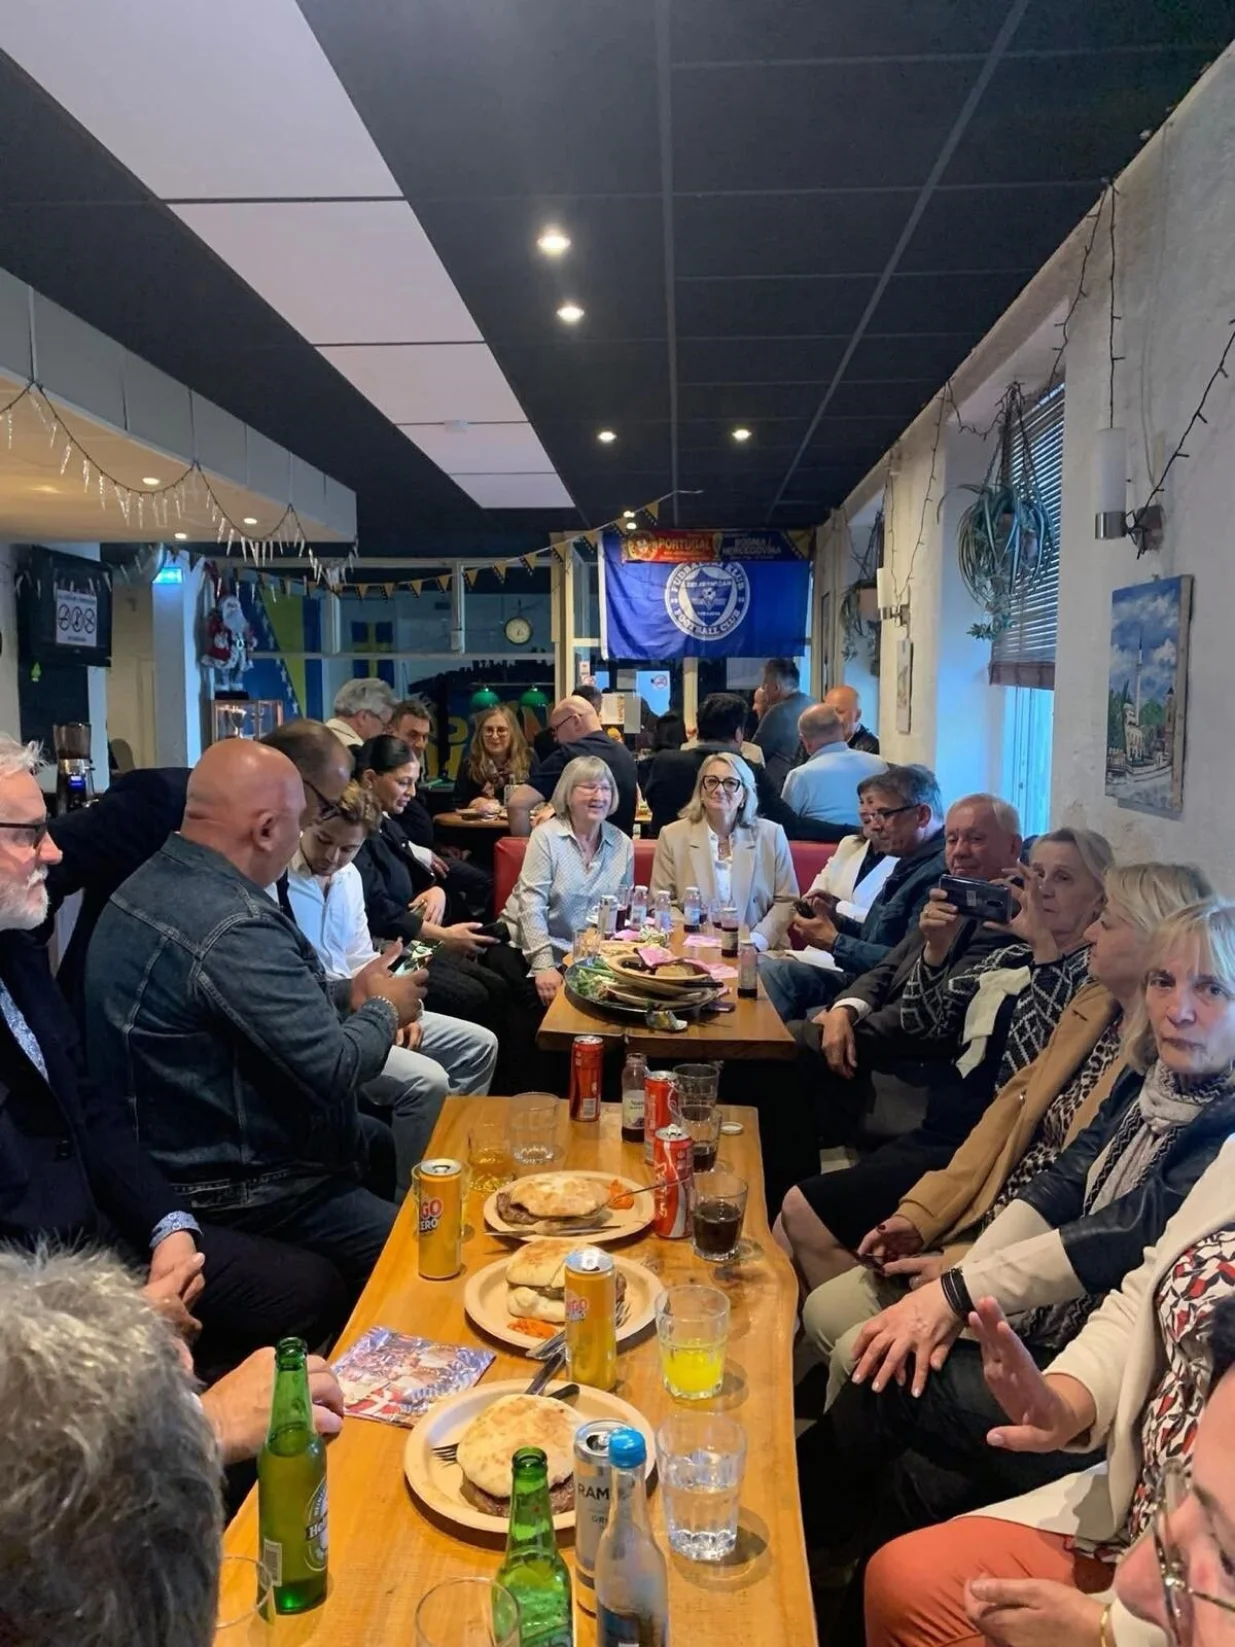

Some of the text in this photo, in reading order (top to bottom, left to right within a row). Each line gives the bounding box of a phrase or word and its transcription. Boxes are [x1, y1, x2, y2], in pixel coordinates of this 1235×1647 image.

[659, 537, 711, 550] PORTUGAL
[674, 609, 741, 635] FOOTBALL CLUB
